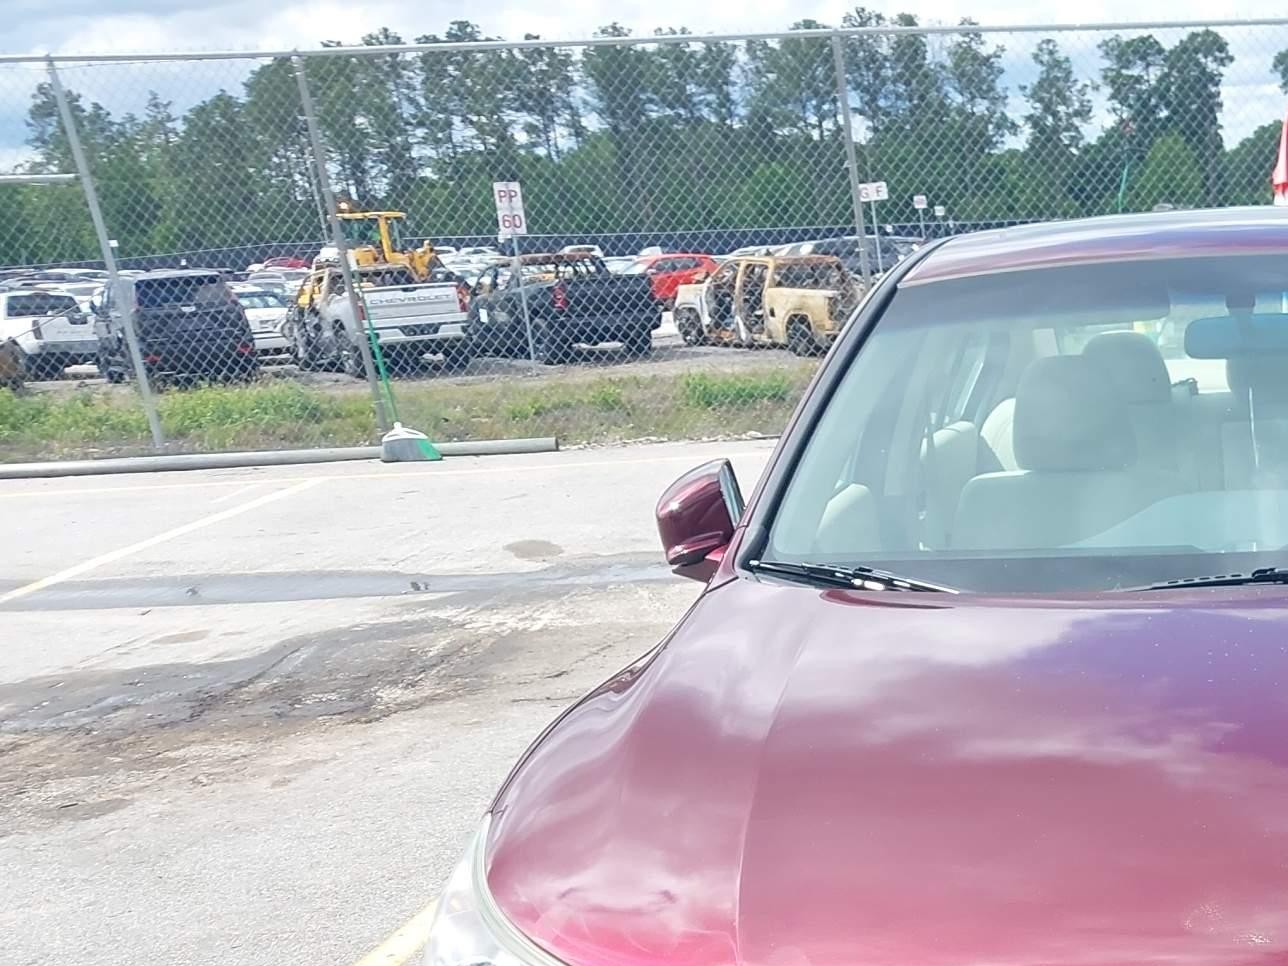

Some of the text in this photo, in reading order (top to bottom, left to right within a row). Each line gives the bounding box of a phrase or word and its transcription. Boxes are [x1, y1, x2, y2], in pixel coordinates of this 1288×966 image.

[498, 190, 518, 203] PP
[502, 214, 522, 229] 60
[370, 294, 451, 305] CHEVROLET
